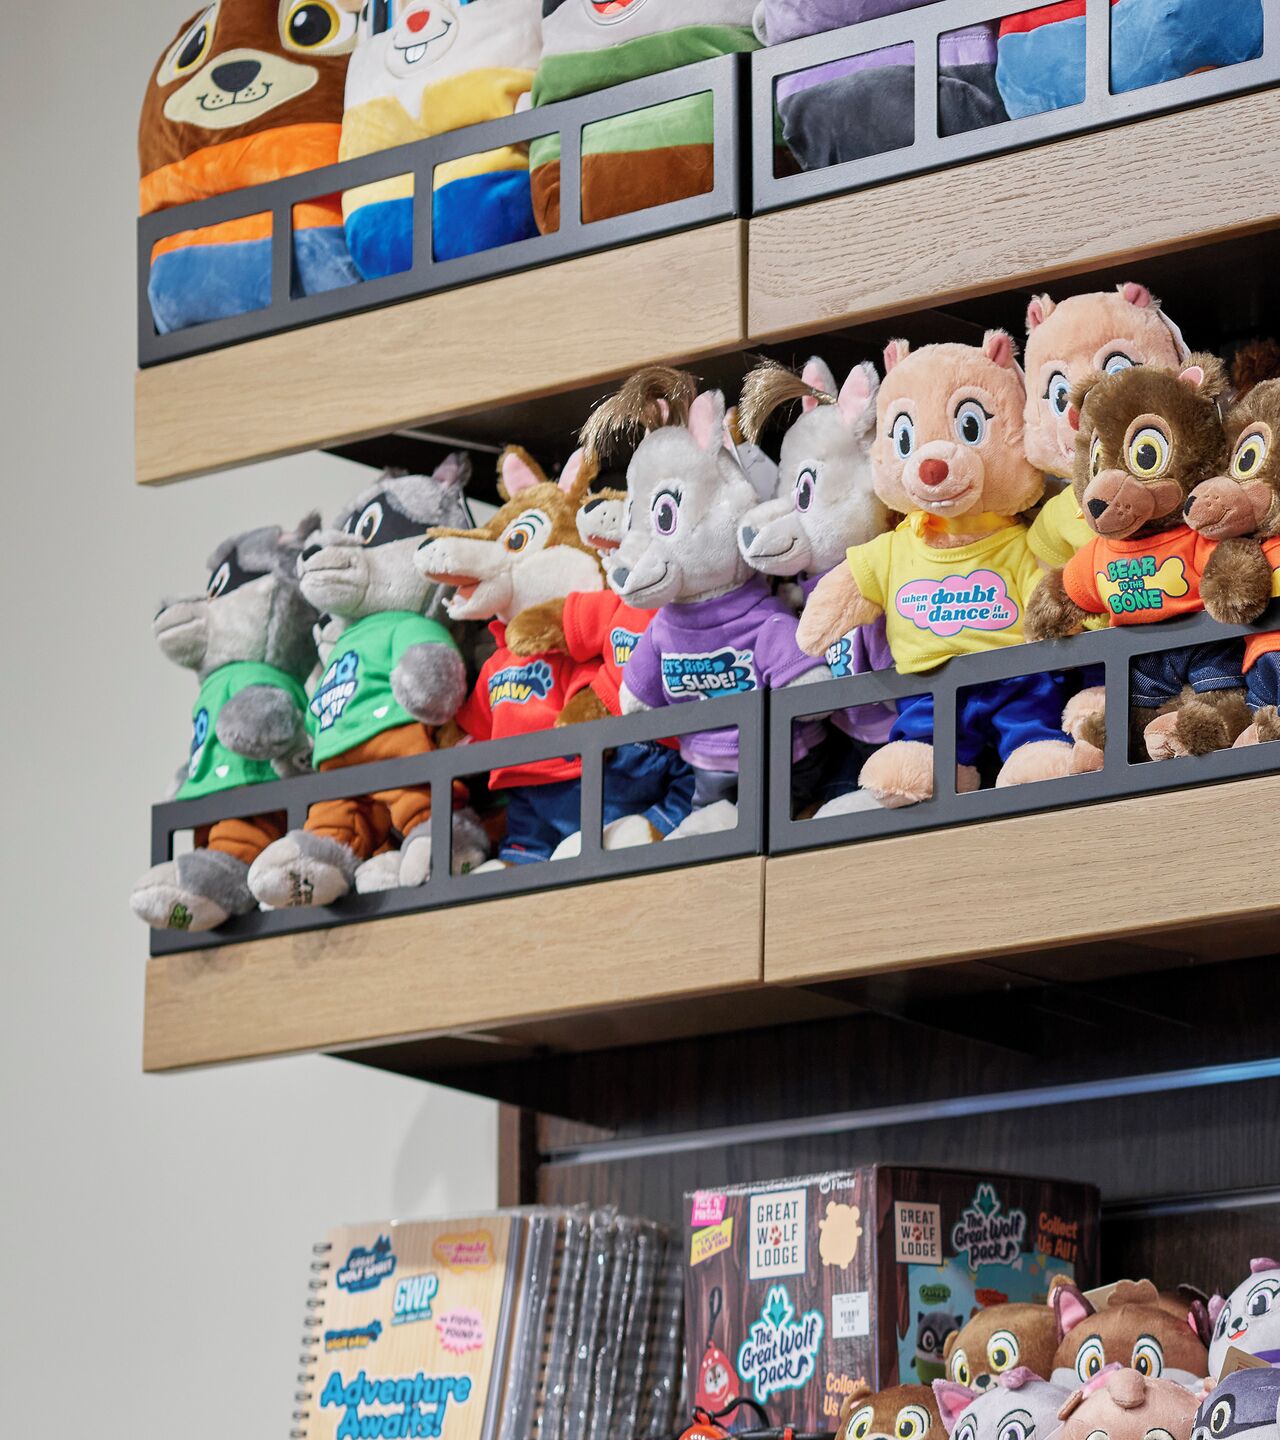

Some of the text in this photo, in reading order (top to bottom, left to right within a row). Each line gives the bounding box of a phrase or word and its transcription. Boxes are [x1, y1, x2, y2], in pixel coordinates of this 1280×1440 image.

[1107, 556, 1156, 582] BEAR
[931, 584, 997, 606] doubt
[1118, 580, 1144, 591] TO THE
[902, 594, 928, 604] when
[915, 602, 927, 613] in
[993, 604, 1002, 613] it
[1109, 590, 1162, 614] BONE
[928, 606, 990, 623] dance
[992, 611, 1009, 620] out
[757, 1201, 799, 1223] GREAT
[900, 1208, 935, 1225] GREAT
[966, 1213, 984, 1230] The
[955, 1212, 1024, 1246] Great Wolf
[1039, 1212, 1078, 1238] Collect
[756, 1246, 798, 1268] LODGE
[901, 1241, 937, 1257] LODGE
[394, 1275, 438, 1314] GWP
[742, 1317, 817, 1372] Great Wolf
[754, 1326, 773, 1348] The
[321, 1370, 472, 1408] Adventure
[823, 1395, 839, 1416] Us
[337, 1401, 447, 1440] Awaits!
